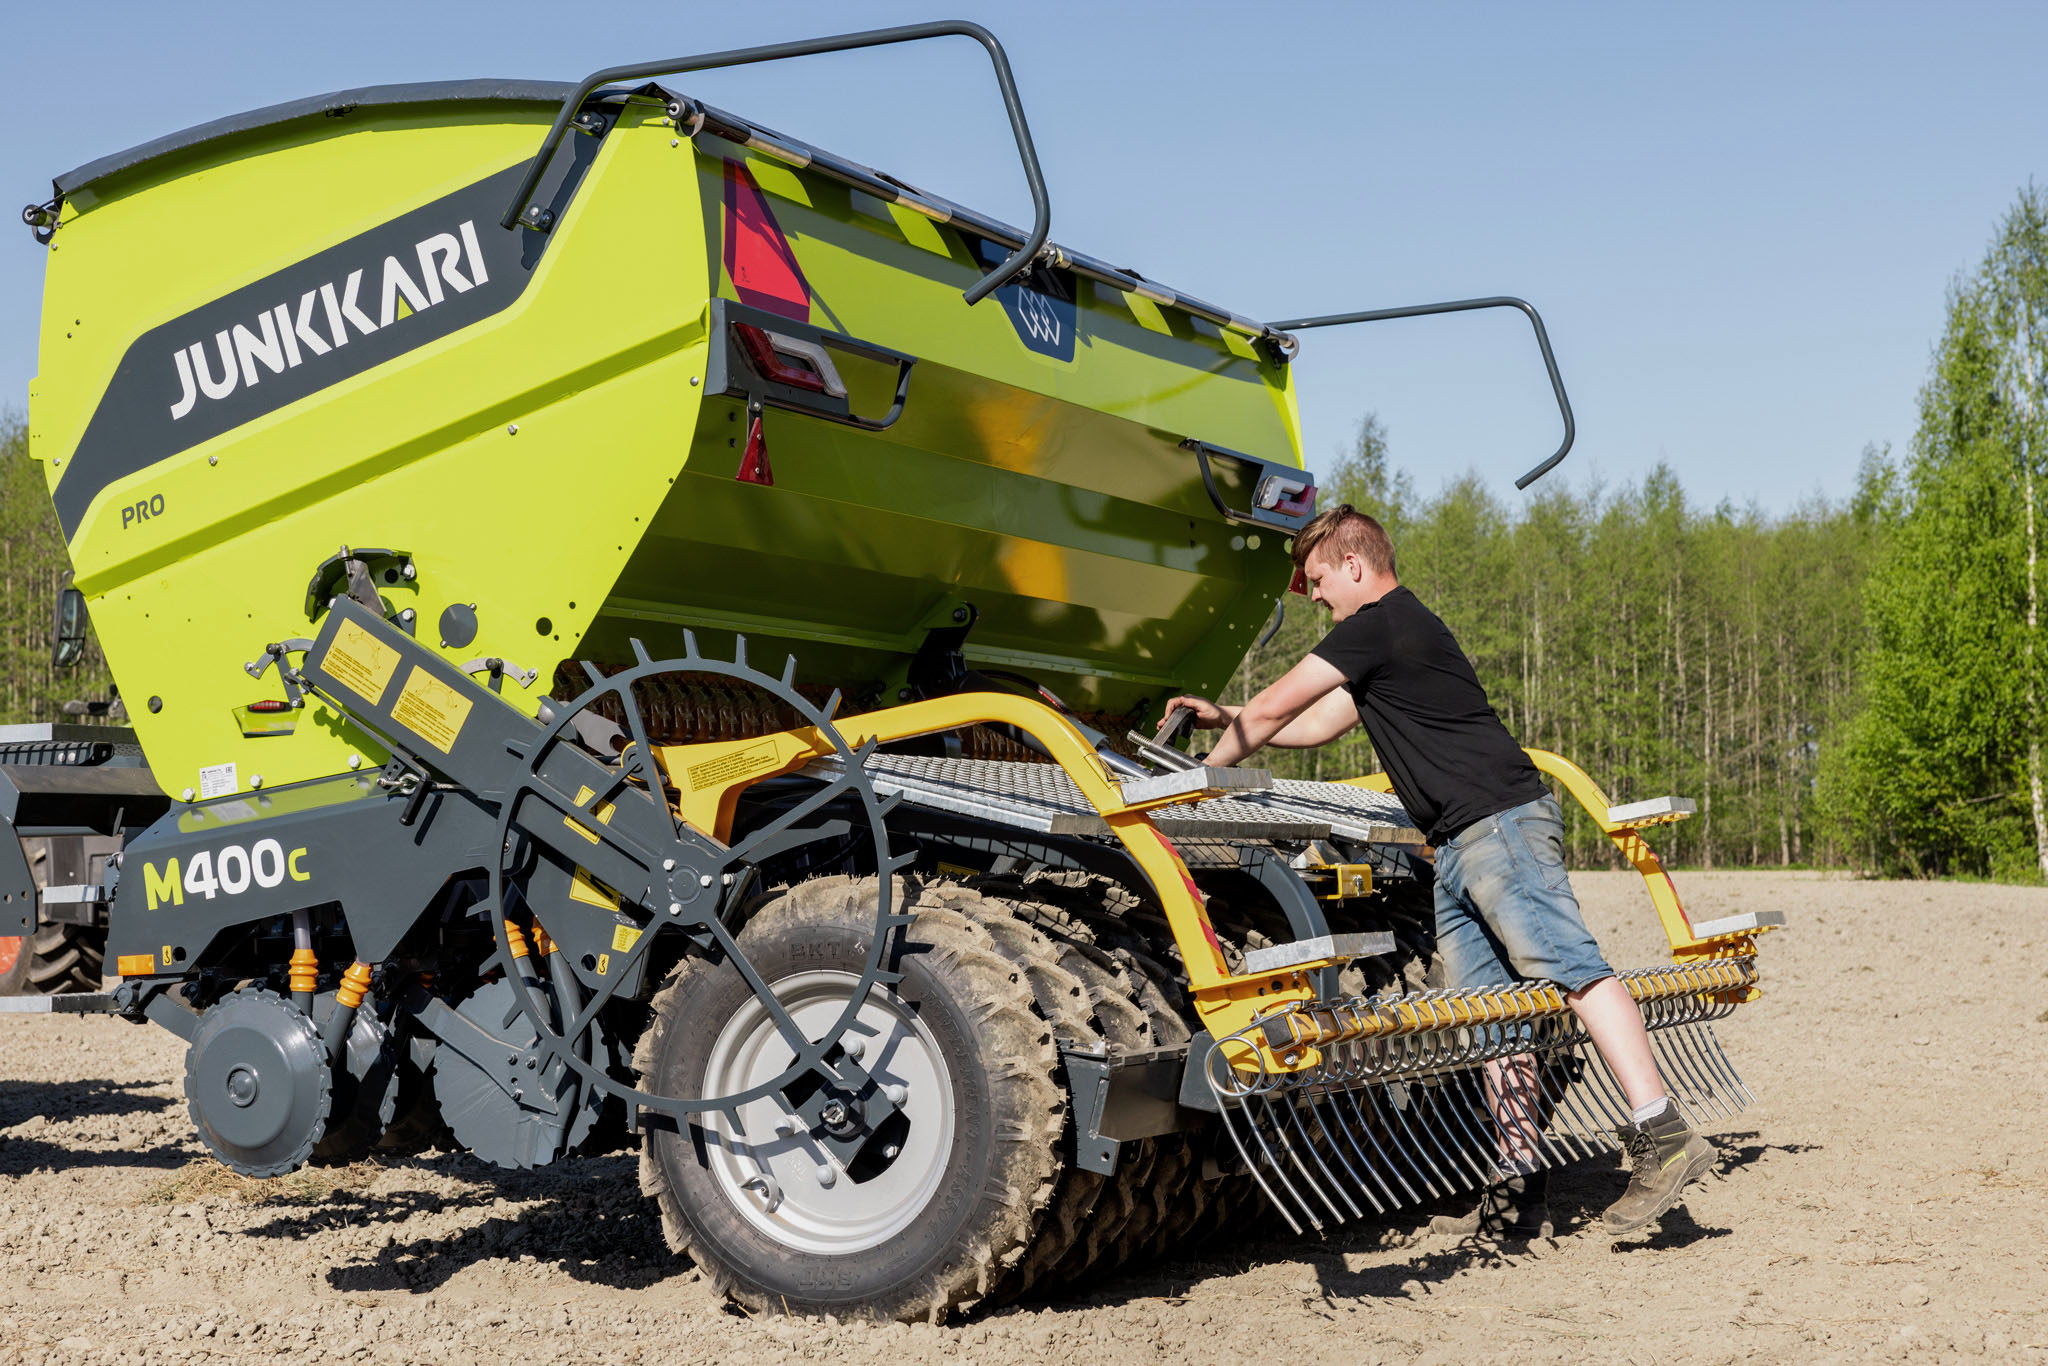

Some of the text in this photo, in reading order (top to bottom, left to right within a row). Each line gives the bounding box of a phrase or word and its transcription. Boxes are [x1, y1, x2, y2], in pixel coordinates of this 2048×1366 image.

[170, 219, 489, 421] JUNKKARI
[122, 493, 165, 530] PRO
[791, 940, 842, 960] BKT
